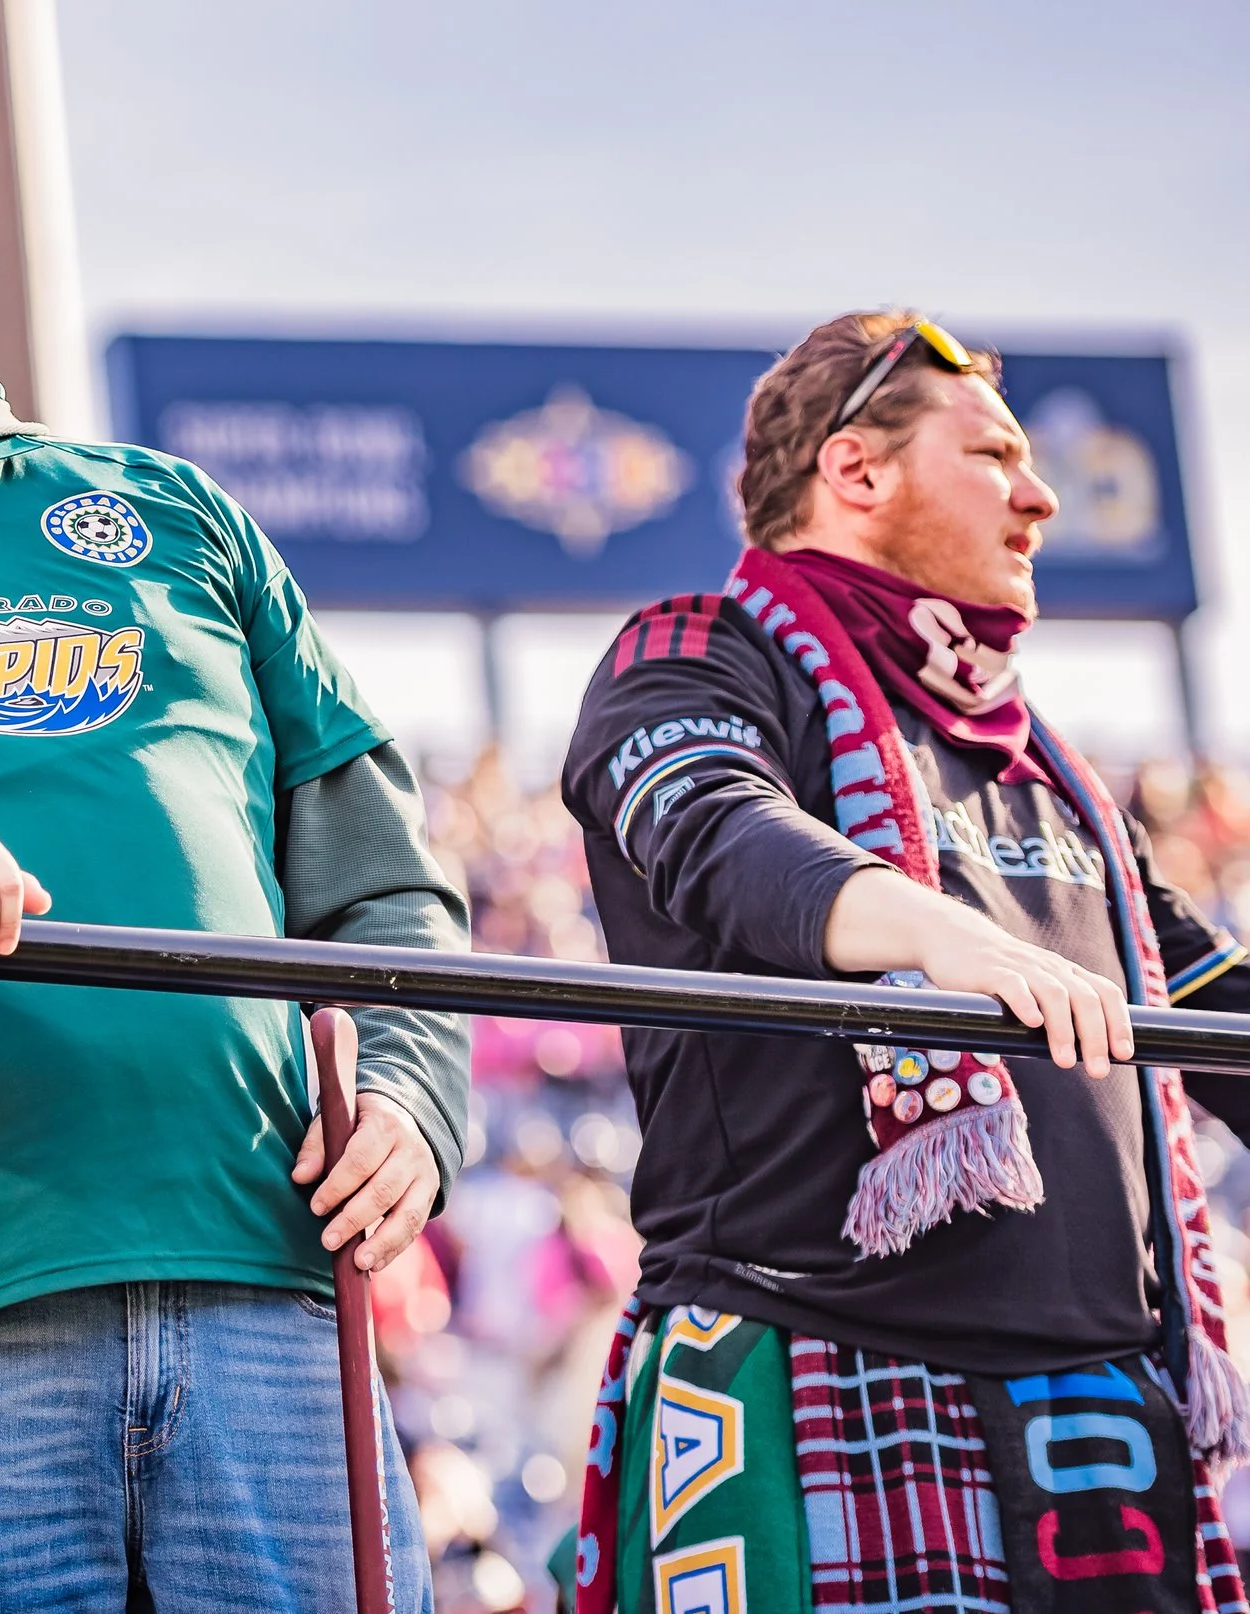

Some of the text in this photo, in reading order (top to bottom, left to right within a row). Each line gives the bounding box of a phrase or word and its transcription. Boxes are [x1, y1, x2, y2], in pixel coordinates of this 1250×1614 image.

[50, 497, 139, 535] COLORADO
[71, 538, 144, 561] RAPIDS
[607, 714, 762, 791] Kiewit
